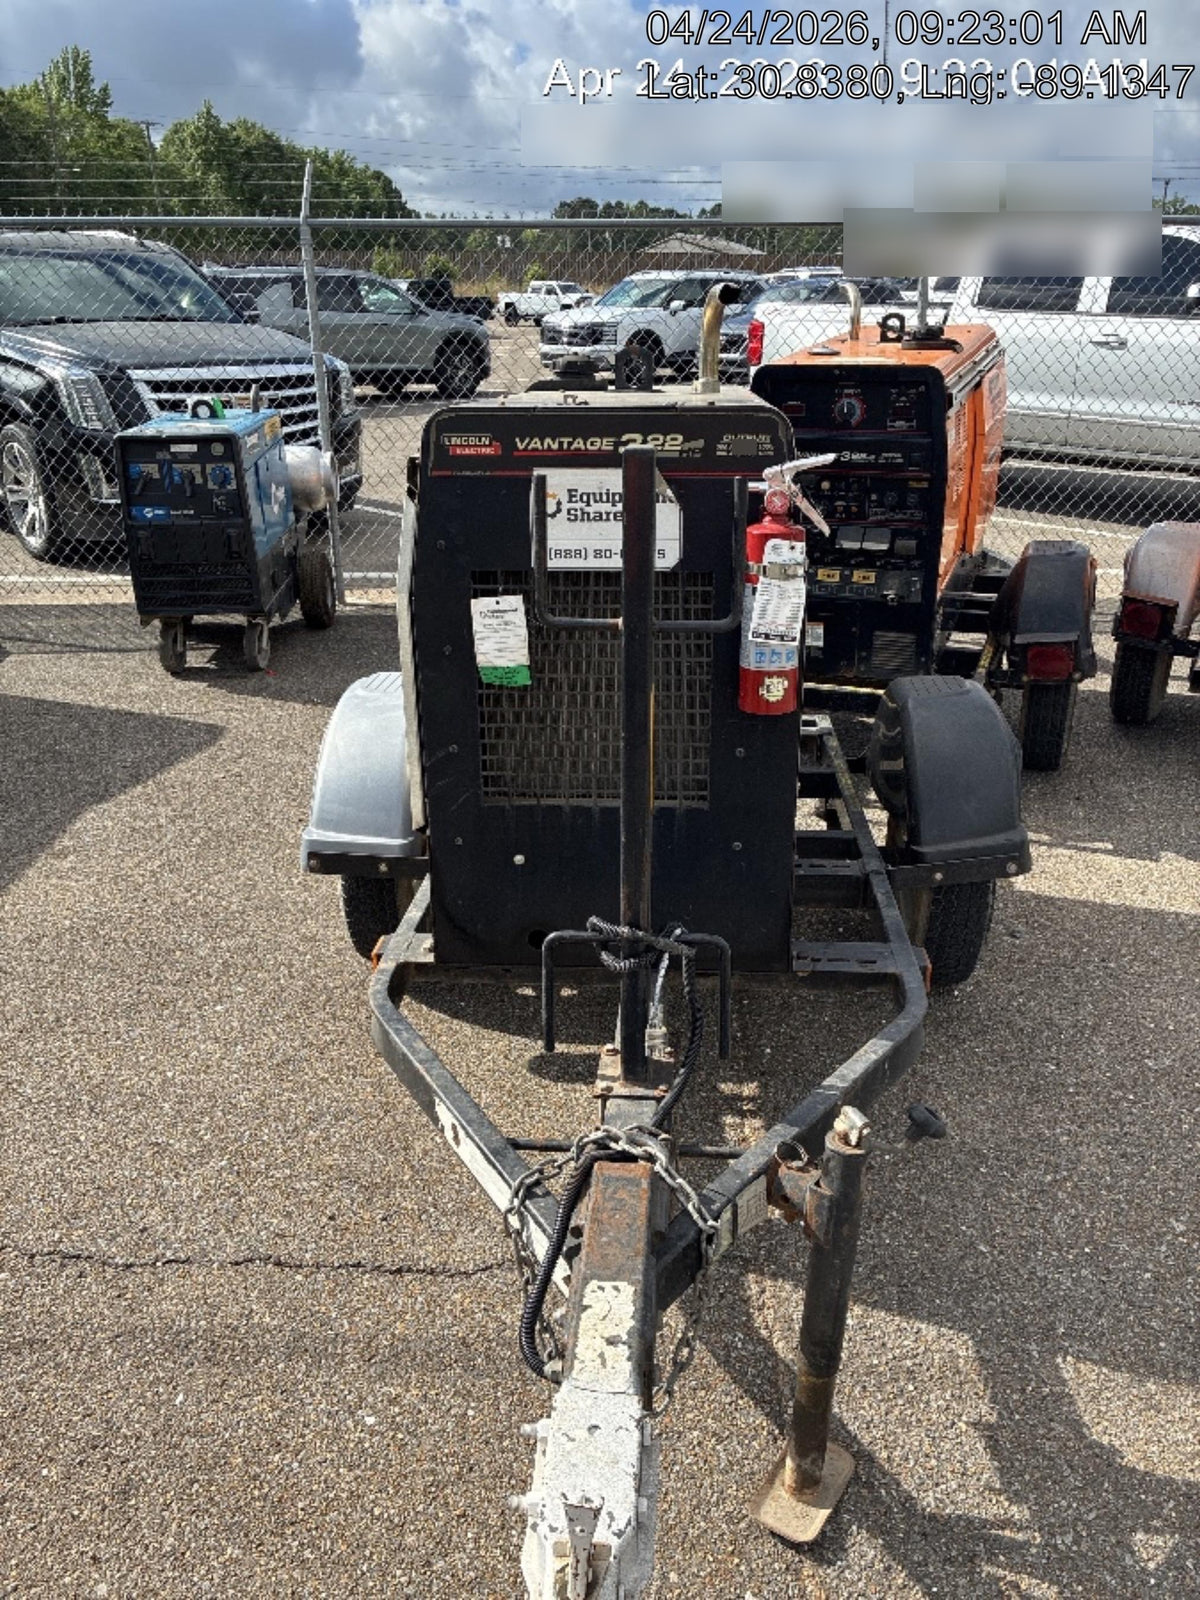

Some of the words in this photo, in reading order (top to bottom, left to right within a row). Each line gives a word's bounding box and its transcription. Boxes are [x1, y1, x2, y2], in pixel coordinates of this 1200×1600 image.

[443, 435, 491, 446] LINCOLN
[515, 436, 615, 450] VANTAGE
[456, 446, 496, 455] ELECTRIC
[566, 508, 624, 523] Share
